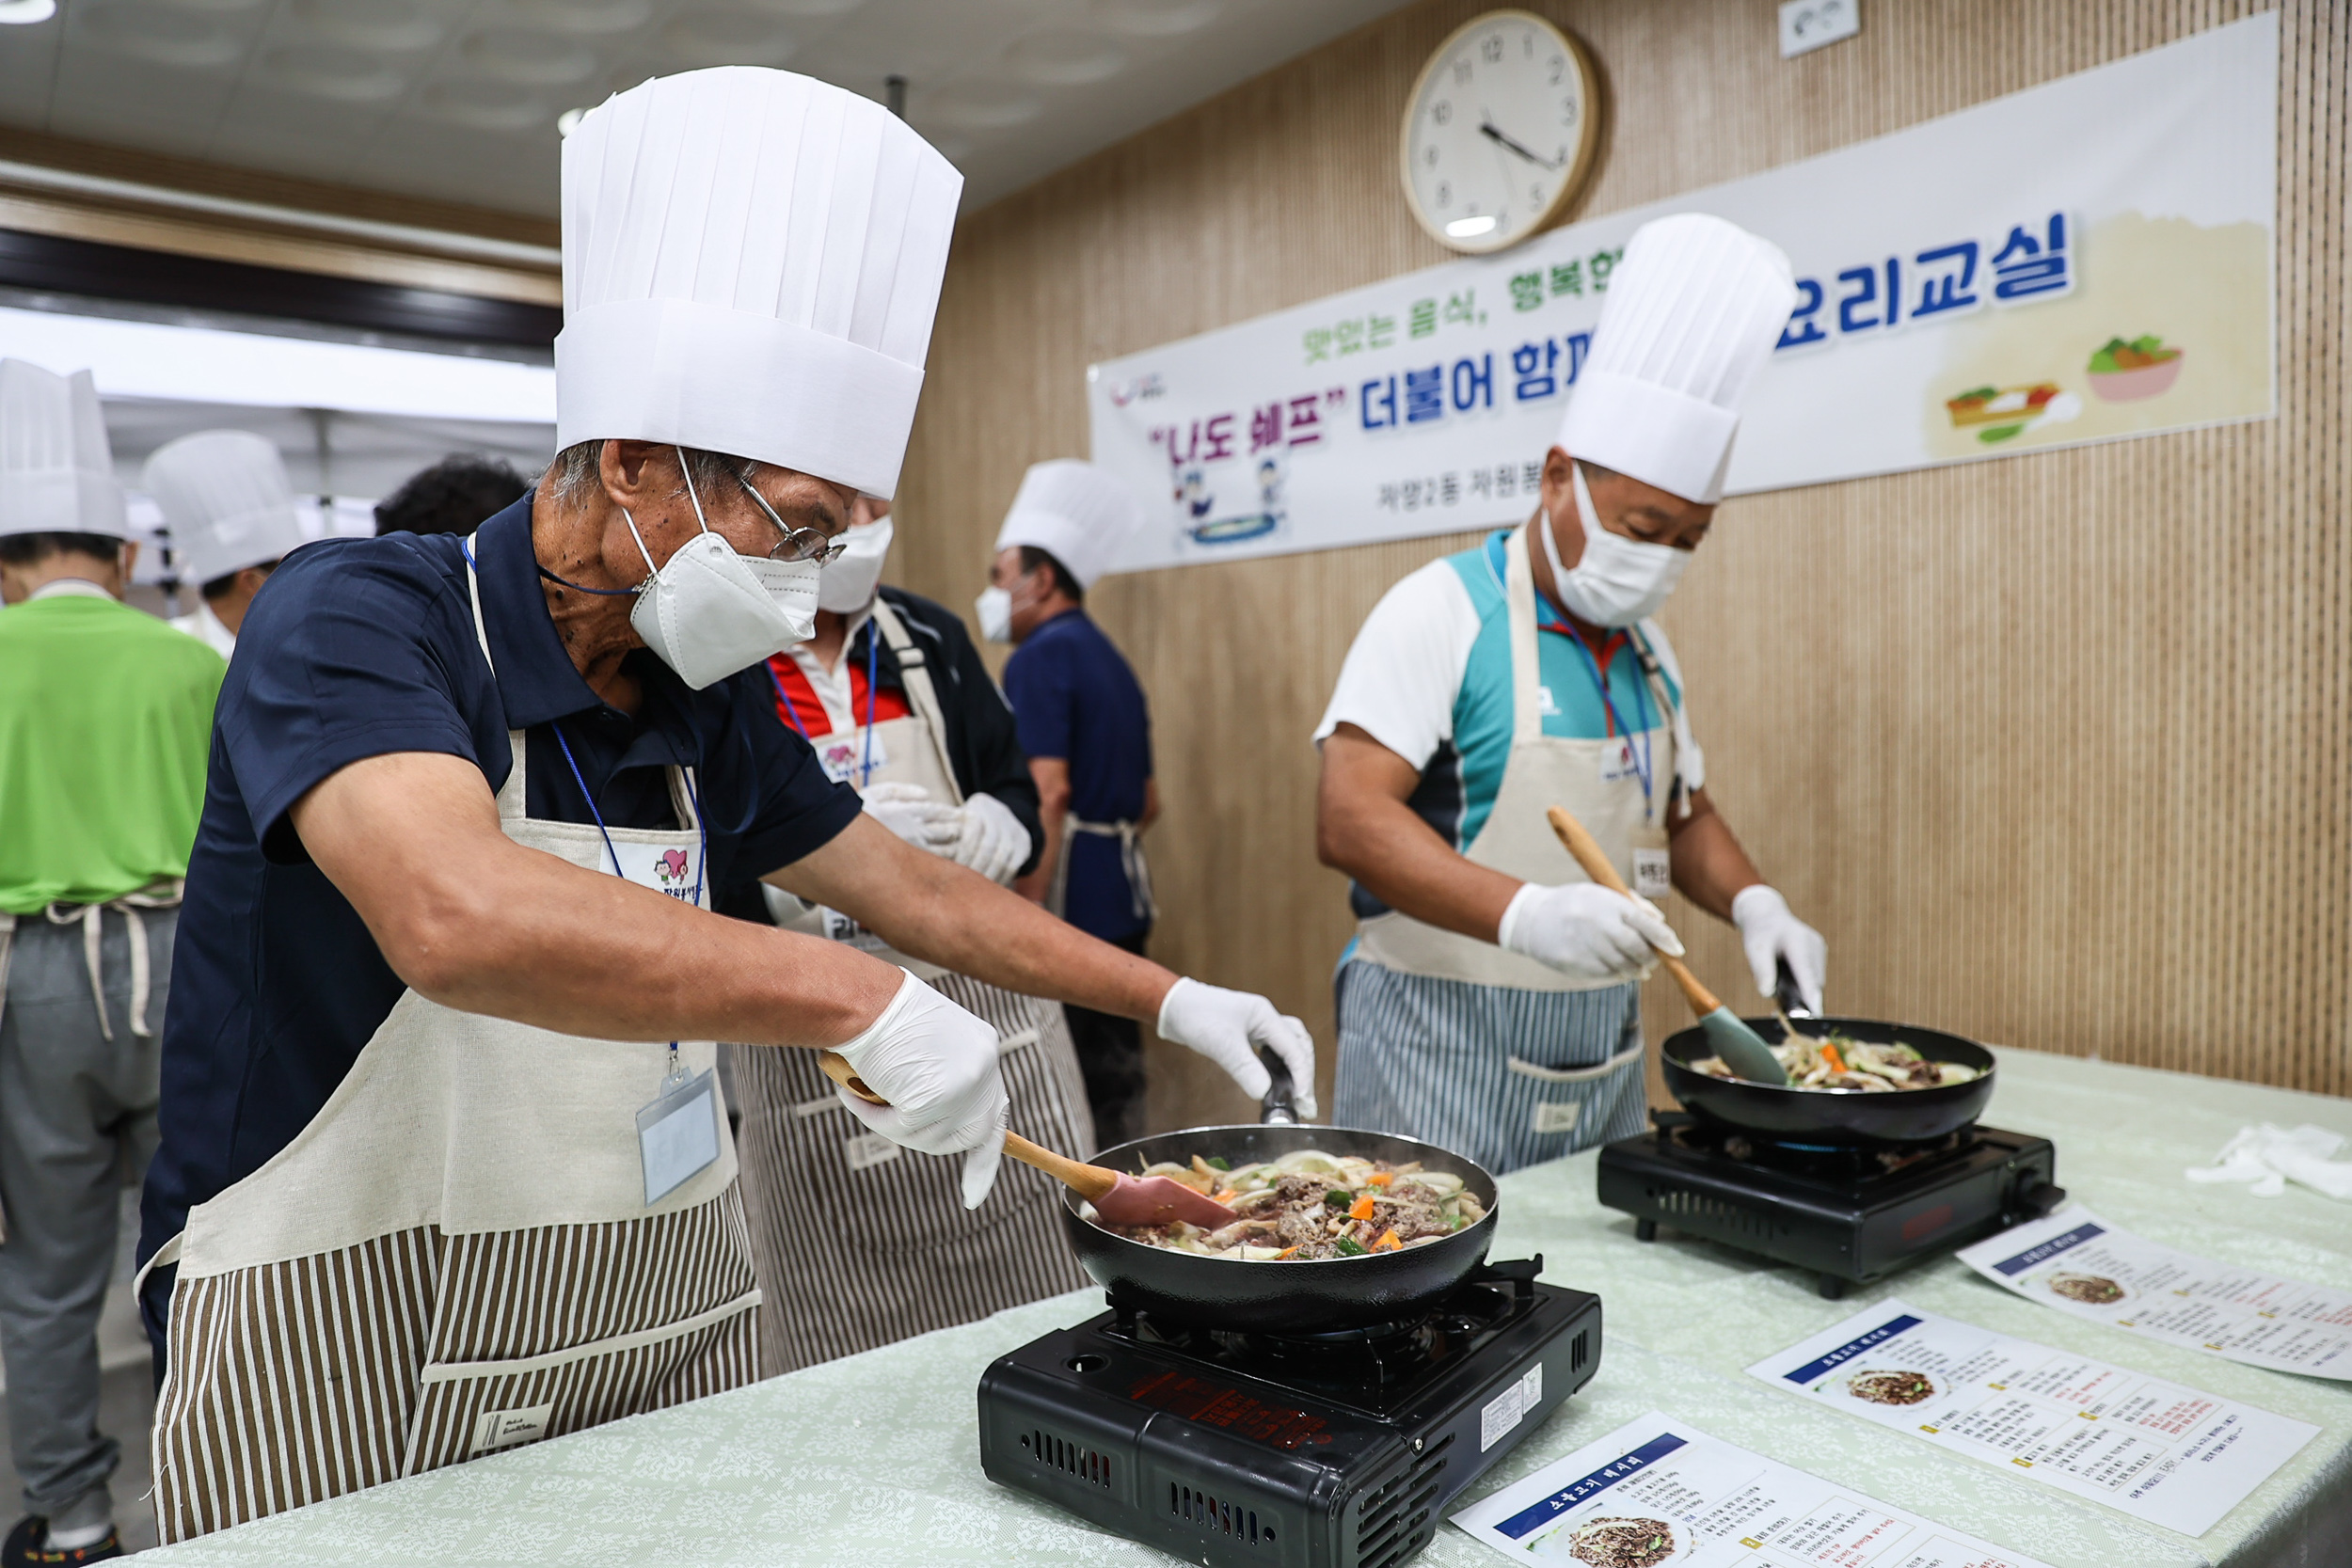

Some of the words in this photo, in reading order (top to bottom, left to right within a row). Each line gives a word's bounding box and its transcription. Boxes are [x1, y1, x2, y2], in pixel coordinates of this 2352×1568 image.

[1481, 34, 1504, 65] 12
[1302, 312, 1396, 365] 맛있는
[1408, 286, 1488, 341] 음식,
[1361, 353, 1493, 430] 더불어
[1550, 1479, 1602, 1510] 소불고기
[1603, 1456, 1643, 1478] 레시피
[1630, 1488, 1646, 1498] 소고기
[1645, 1478, 1666, 1489] 불고기용
[2129, 1489, 2143, 1498] 아주
[2159, 1460, 2176, 1472] EASY
[1661, 1497, 1686, 1513] 느타리버섯
[1682, 1513, 1696, 1523] 양념
[1693, 1517, 1710, 1528] 진간장
[1754, 1531, 1769, 1541] 재료
[1767, 1517, 1791, 1532] 준비하기
[1777, 1534, 1795, 1544] 대파는
[1789, 1539, 1808, 1550] 양파와
[1804, 1530, 1820, 1539] 당근
[1803, 1535, 1833, 1556] 느타리버섯은
[1832, 1524, 1849, 1535] 가늘게
